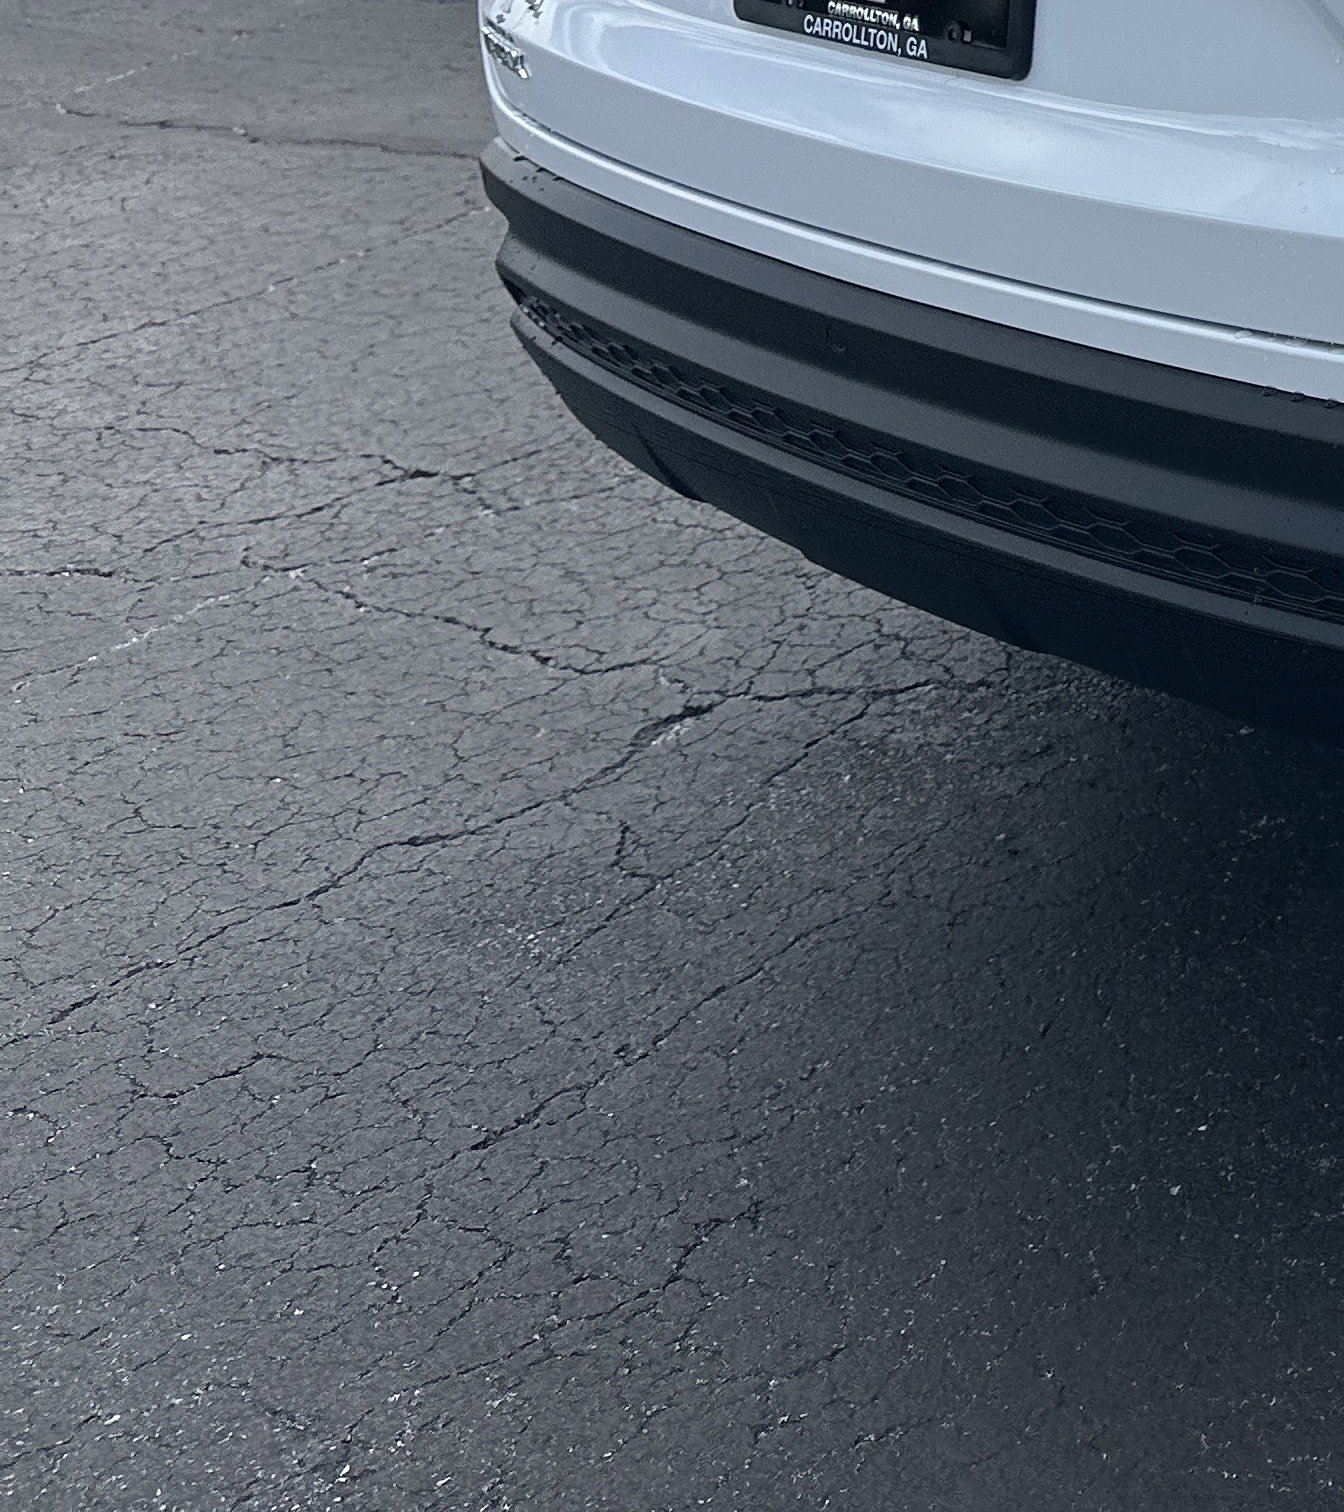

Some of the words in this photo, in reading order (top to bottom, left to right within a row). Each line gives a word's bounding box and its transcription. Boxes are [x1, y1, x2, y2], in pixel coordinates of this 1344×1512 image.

[803, 14, 902, 56] CARROLLTON,
[906, 36, 928, 59] GA
[903, 13, 920, 32] GA
